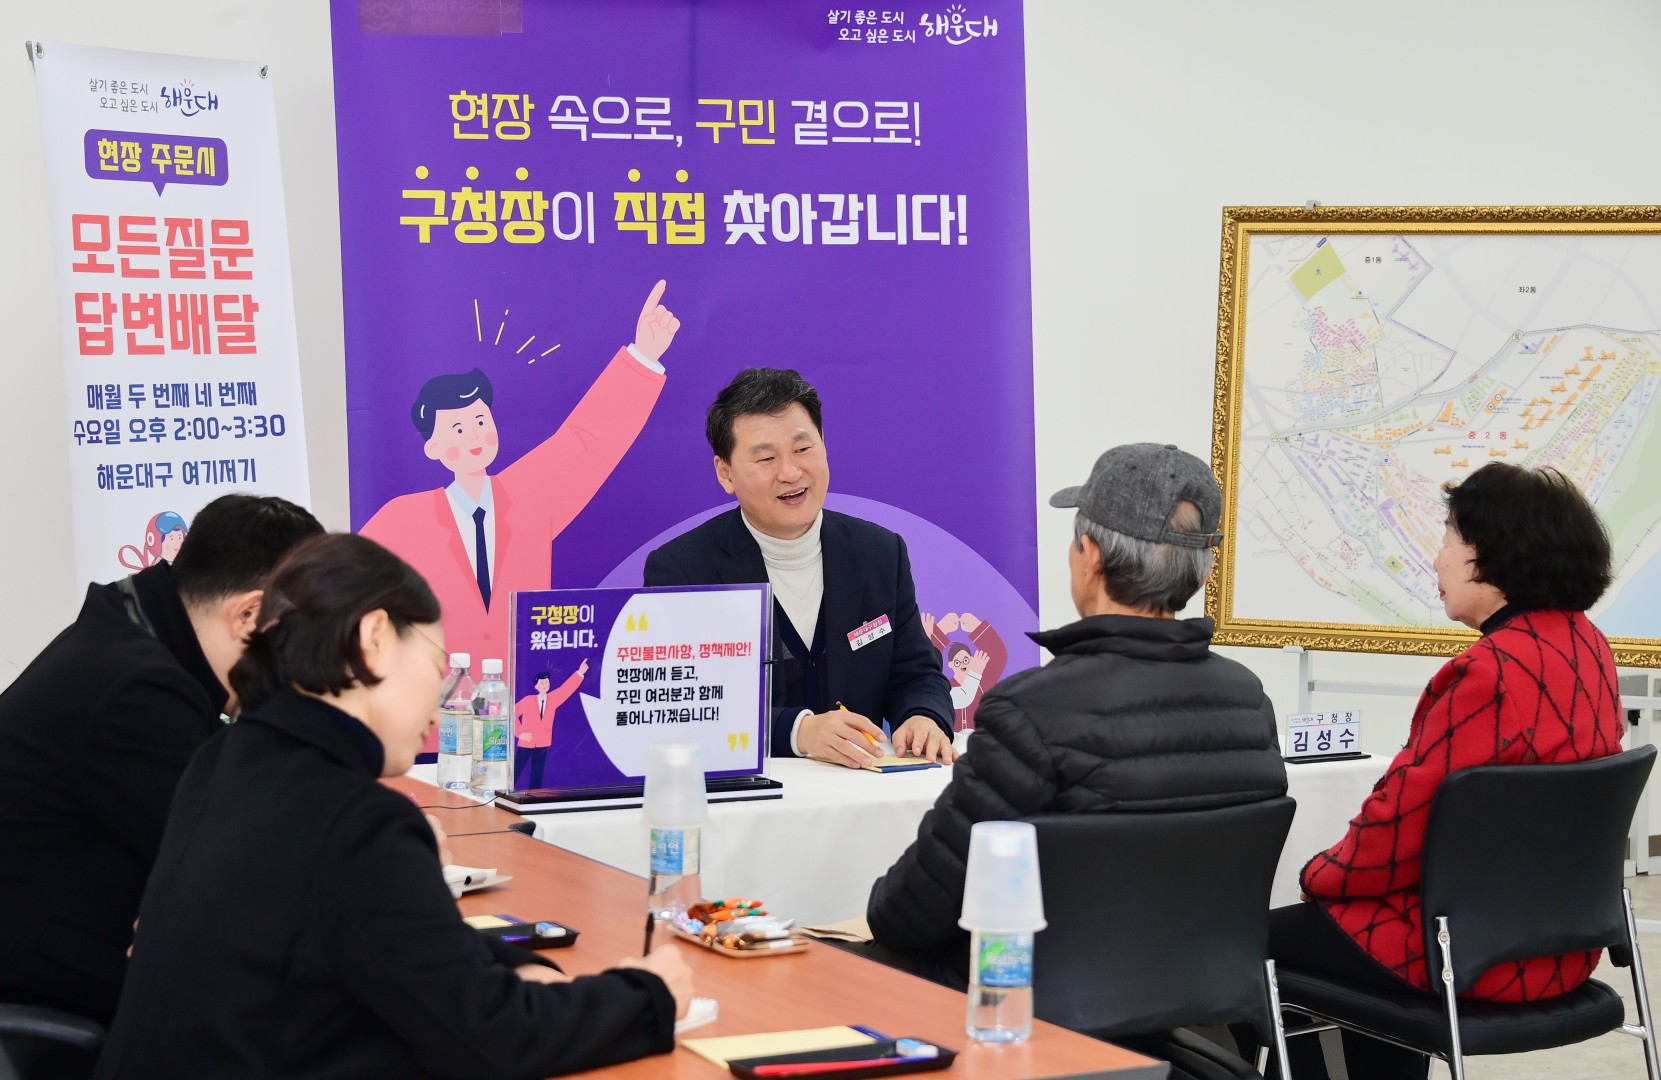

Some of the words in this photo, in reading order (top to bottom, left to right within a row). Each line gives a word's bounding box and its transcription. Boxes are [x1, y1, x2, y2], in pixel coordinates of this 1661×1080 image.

[828, 10, 850, 24] 살기
[855, 10, 877, 25] 좋은
[881, 12, 904, 24] 도시
[919, 12, 998, 45] 해운대
[838, 28, 862, 40] 오고
[866, 29, 889, 43] 싶은
[892, 30, 915, 43] 도시
[89, 79, 107, 92] 살기
[110, 81, 127, 94] 좋은
[131, 83, 147, 95] 도시
[100, 97, 117, 109] 오고
[121, 99, 137, 112] 싶은
[141, 101, 158, 113] 도시
[160, 86, 218, 117] 해운대
[449, 90, 535, 140] 현장
[549, 95, 682, 147] 속으로,
[696, 99, 775, 144] 구민
[791, 101, 920, 146] 곁으로!
[98, 138, 142, 172] 현장
[151, 144, 215, 176] 주문시
[400, 187, 594, 244] 구청장이
[614, 192, 705, 244] 직접
[724, 190, 967, 245] 찾아갑니다!
[72, 214, 254, 280] 모든질문
[1518, 286, 1536, 294] 좌2동
[75, 292, 259, 355] 답변배달
[87, 384, 121, 410] 매월
[128, 384, 146, 409] 두
[153, 383, 189, 408] 번째
[195, 383, 212, 407] 네
[219, 382, 257, 406] 번째
[74, 419, 121, 446] 수요일
[129, 417, 166, 443] 오후
[174, 415, 285, 440] 2:00~3:30
[97, 463, 173, 490] 해운대구
[182, 459, 256, 485] 여기저기
[531, 605, 594, 625] 구청장이
[531, 629, 598, 650] 왔습니다.
[617, 644, 695, 661] 주민불편사항,
[699, 642, 751, 658] 정책제안!
[617, 667, 666, 683] 현장에서
[671, 666, 698, 681] 듣고,
[616, 687, 641, 705] 주민
[645, 686, 695, 702] 여러분과
[699, 685, 723, 700] 함께
[616, 707, 719, 726] 풀어나가겠습니다!
[1293, 728, 1355, 753] 김성수
